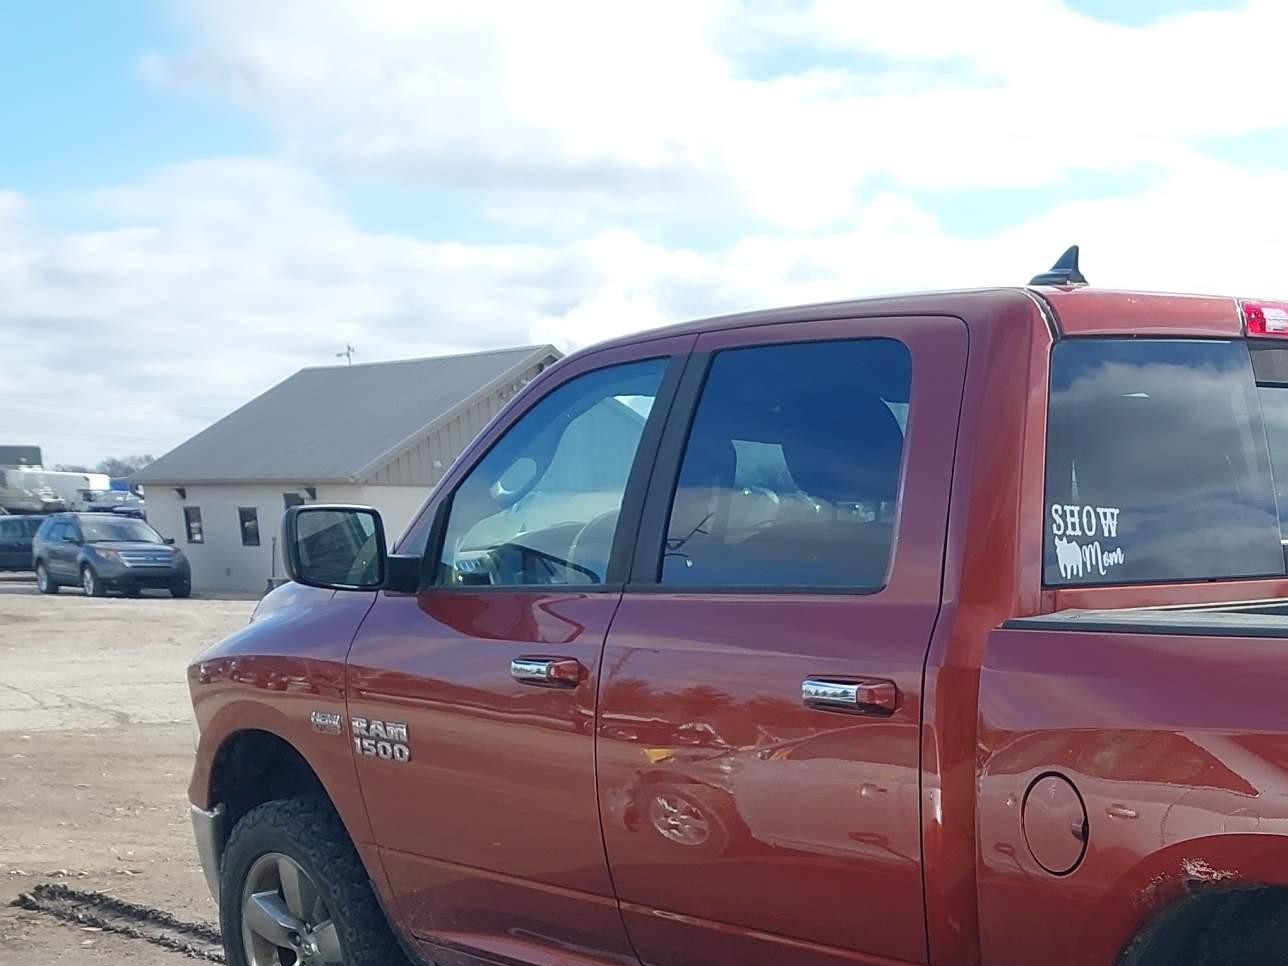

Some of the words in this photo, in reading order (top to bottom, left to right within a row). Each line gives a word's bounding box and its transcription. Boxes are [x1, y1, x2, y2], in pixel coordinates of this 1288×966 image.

[1051, 504, 1120, 537] SHOW
[1081, 541, 1125, 576] Mom
[351, 716, 408, 742] RAM
[353, 736, 410, 763] 1500
